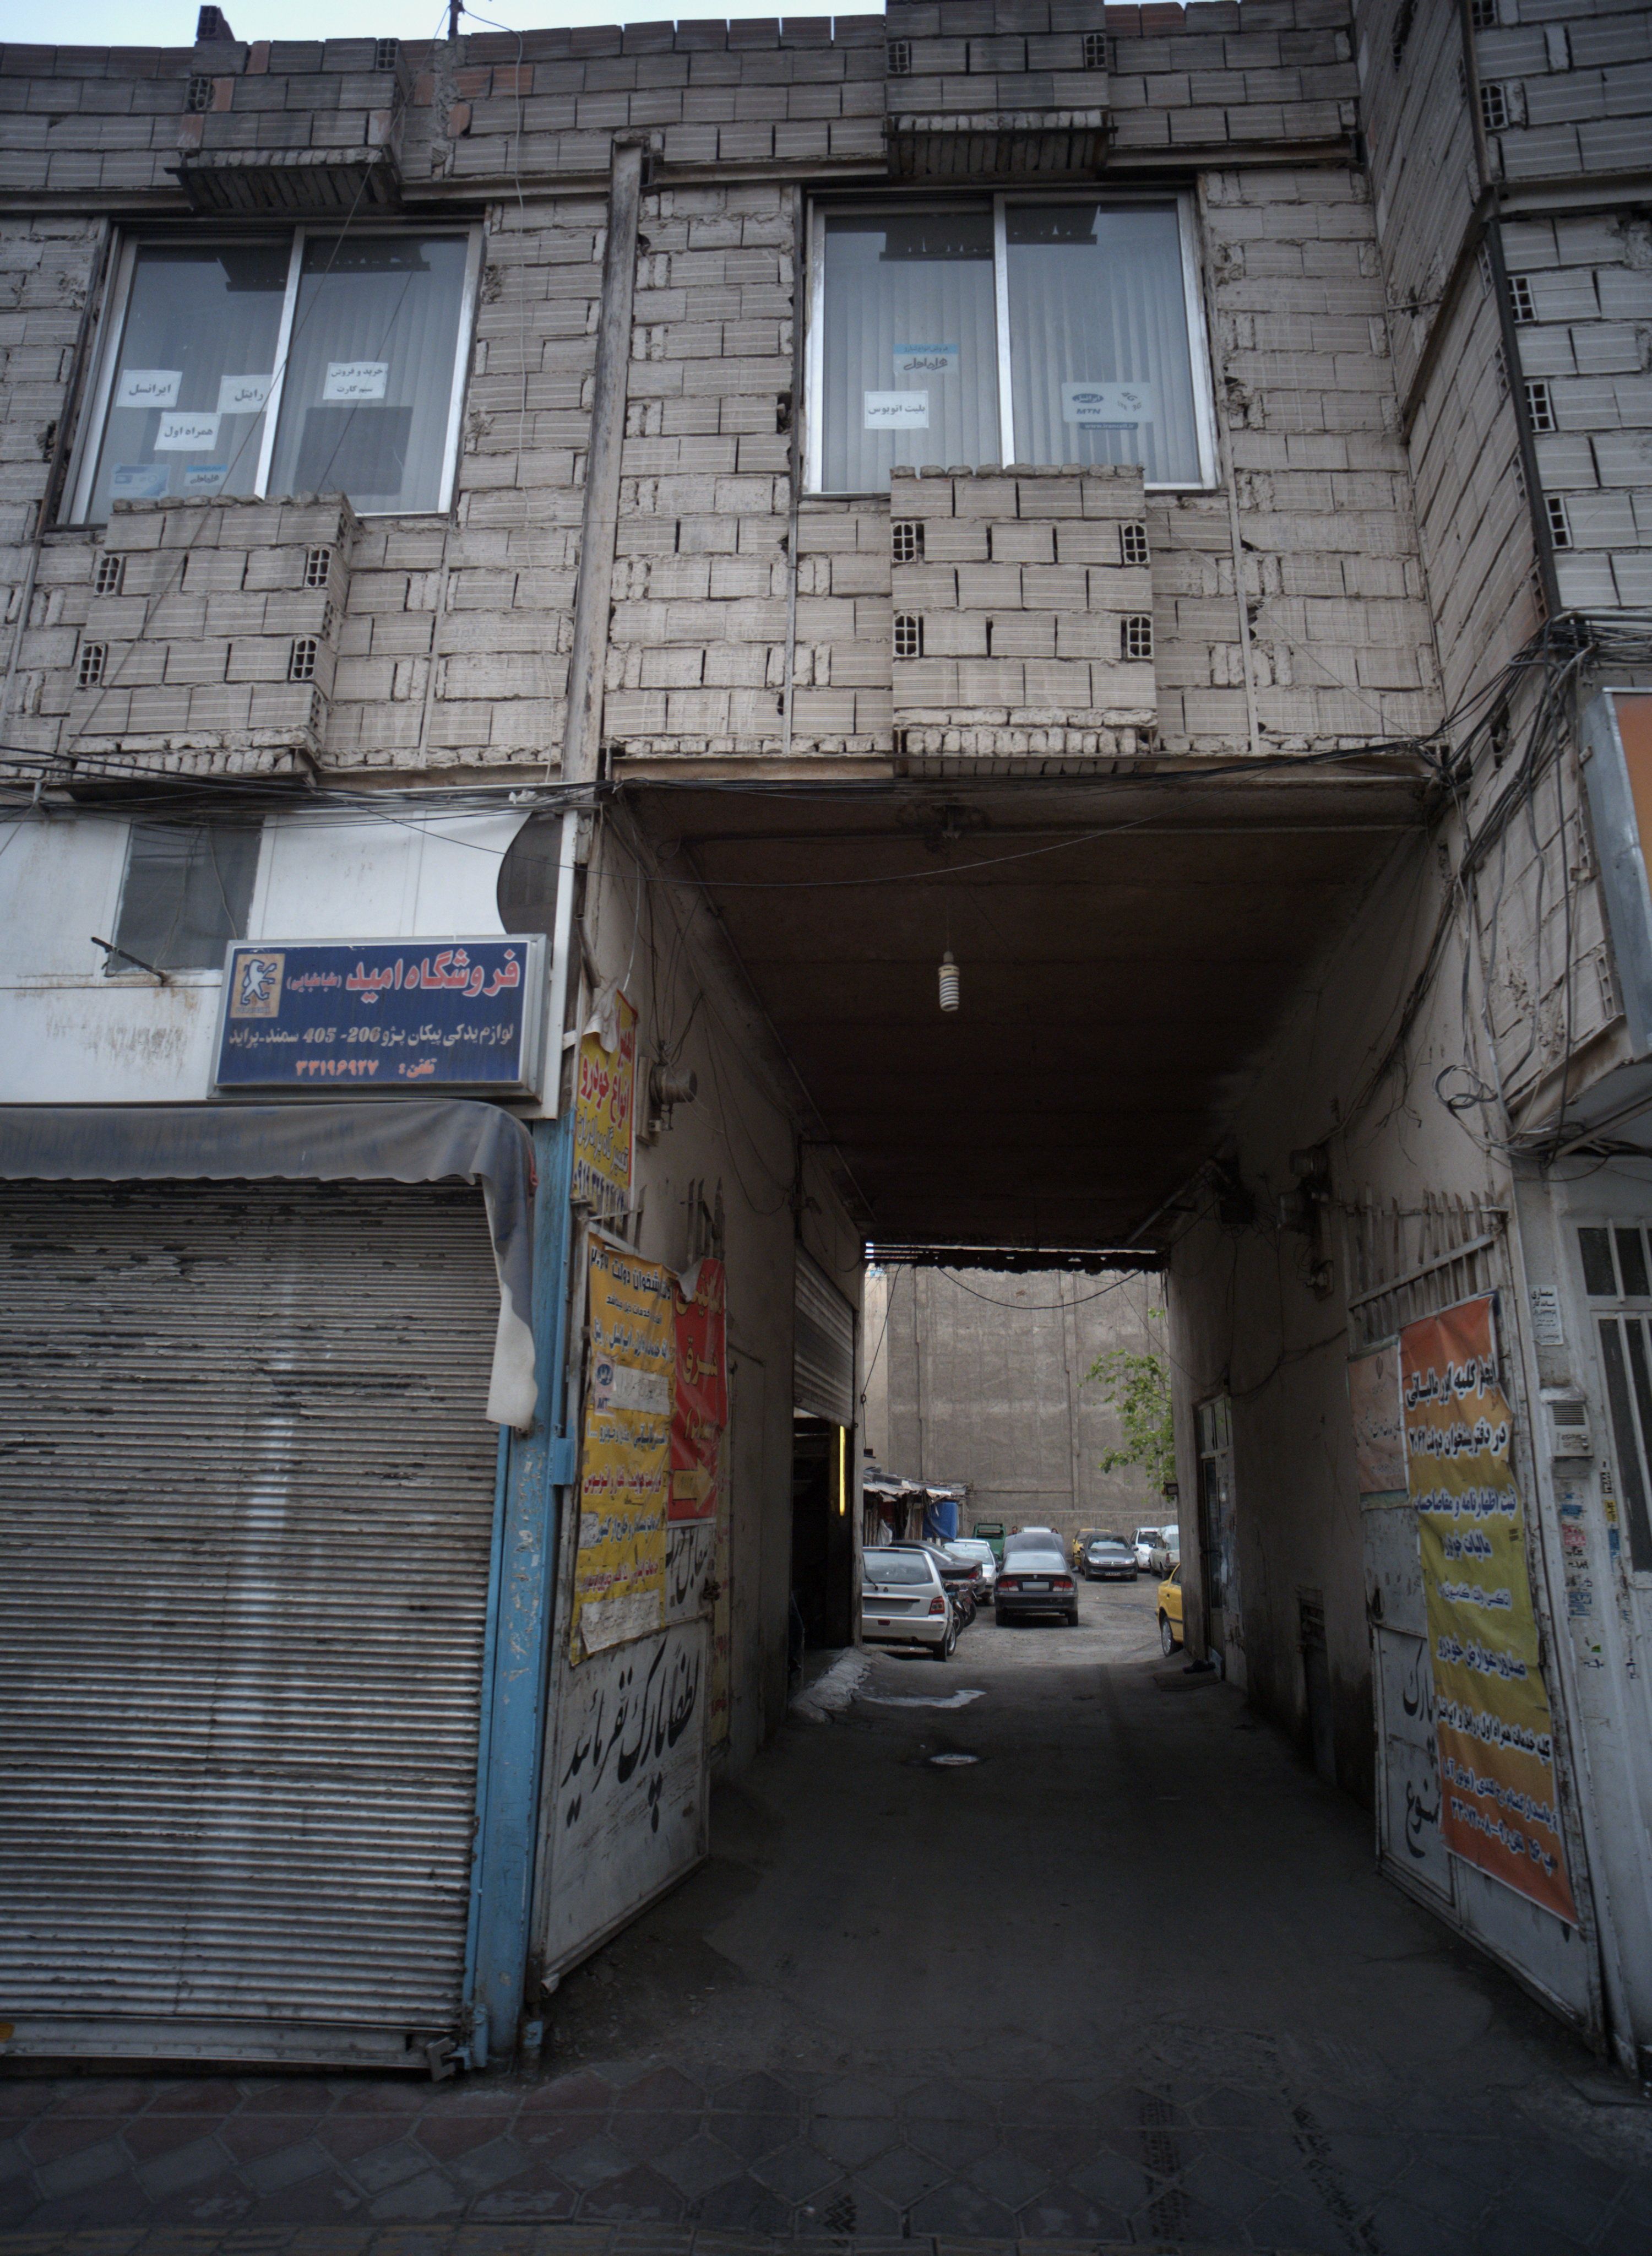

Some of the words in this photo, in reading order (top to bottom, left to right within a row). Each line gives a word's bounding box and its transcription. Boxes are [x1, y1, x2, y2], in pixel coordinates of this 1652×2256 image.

[331, 367, 355, 377] فروش
[362, 367, 383, 377] خرید
[128, 384, 172, 396] ایرانسل
[234, 388, 263, 402] رایتل
[337, 385, 358, 394] کارت
[868, 404, 903, 415] اتوبوس
[905, 404, 926, 414] بلیت
[1132, 402, 1142, 411] 3G
[164, 426, 183, 438] اول
[186, 427, 214, 438] همراه
[345, 958, 403, 1004] امید
[404, 948, 520, 997] فروشگاه
[302, 1027, 337, 1044] 405
[381, 1026, 405, 1046] پژو
[407, 1023, 442, 1046] پیکان
[442, 1023, 478, 1046] یدکی
[480, 1023, 514, 1045] لوازم
[399, 1058, 438, 1078] تلفن:
[580, 1056, 610, 1110] خودرو
[1406, 1371, 1439, 1408] مالیاتی
[1454, 1363, 1476, 1396] کلیه
[1426, 1429, 1443, 1456] دولت
[1444, 1425, 1474, 1456] پیشخوان
[1474, 1421, 1491, 1454] دفتر
[1492, 1425, 1507, 1452] در
[1453, 1499, 1460, 1517] و
[1501, 1488, 1516, 1517] ثبت
[1445, 1532, 1462, 1558] خودرو
[1464, 1533, 1491, 1559] مالیات
[1438, 1637, 1463, 1662] خودرو
[1497, 1655, 1526, 1677] صدور
[617, 1635, 668, 1834] پارک
[1512, 1728, 1535, 1751] خدمات
